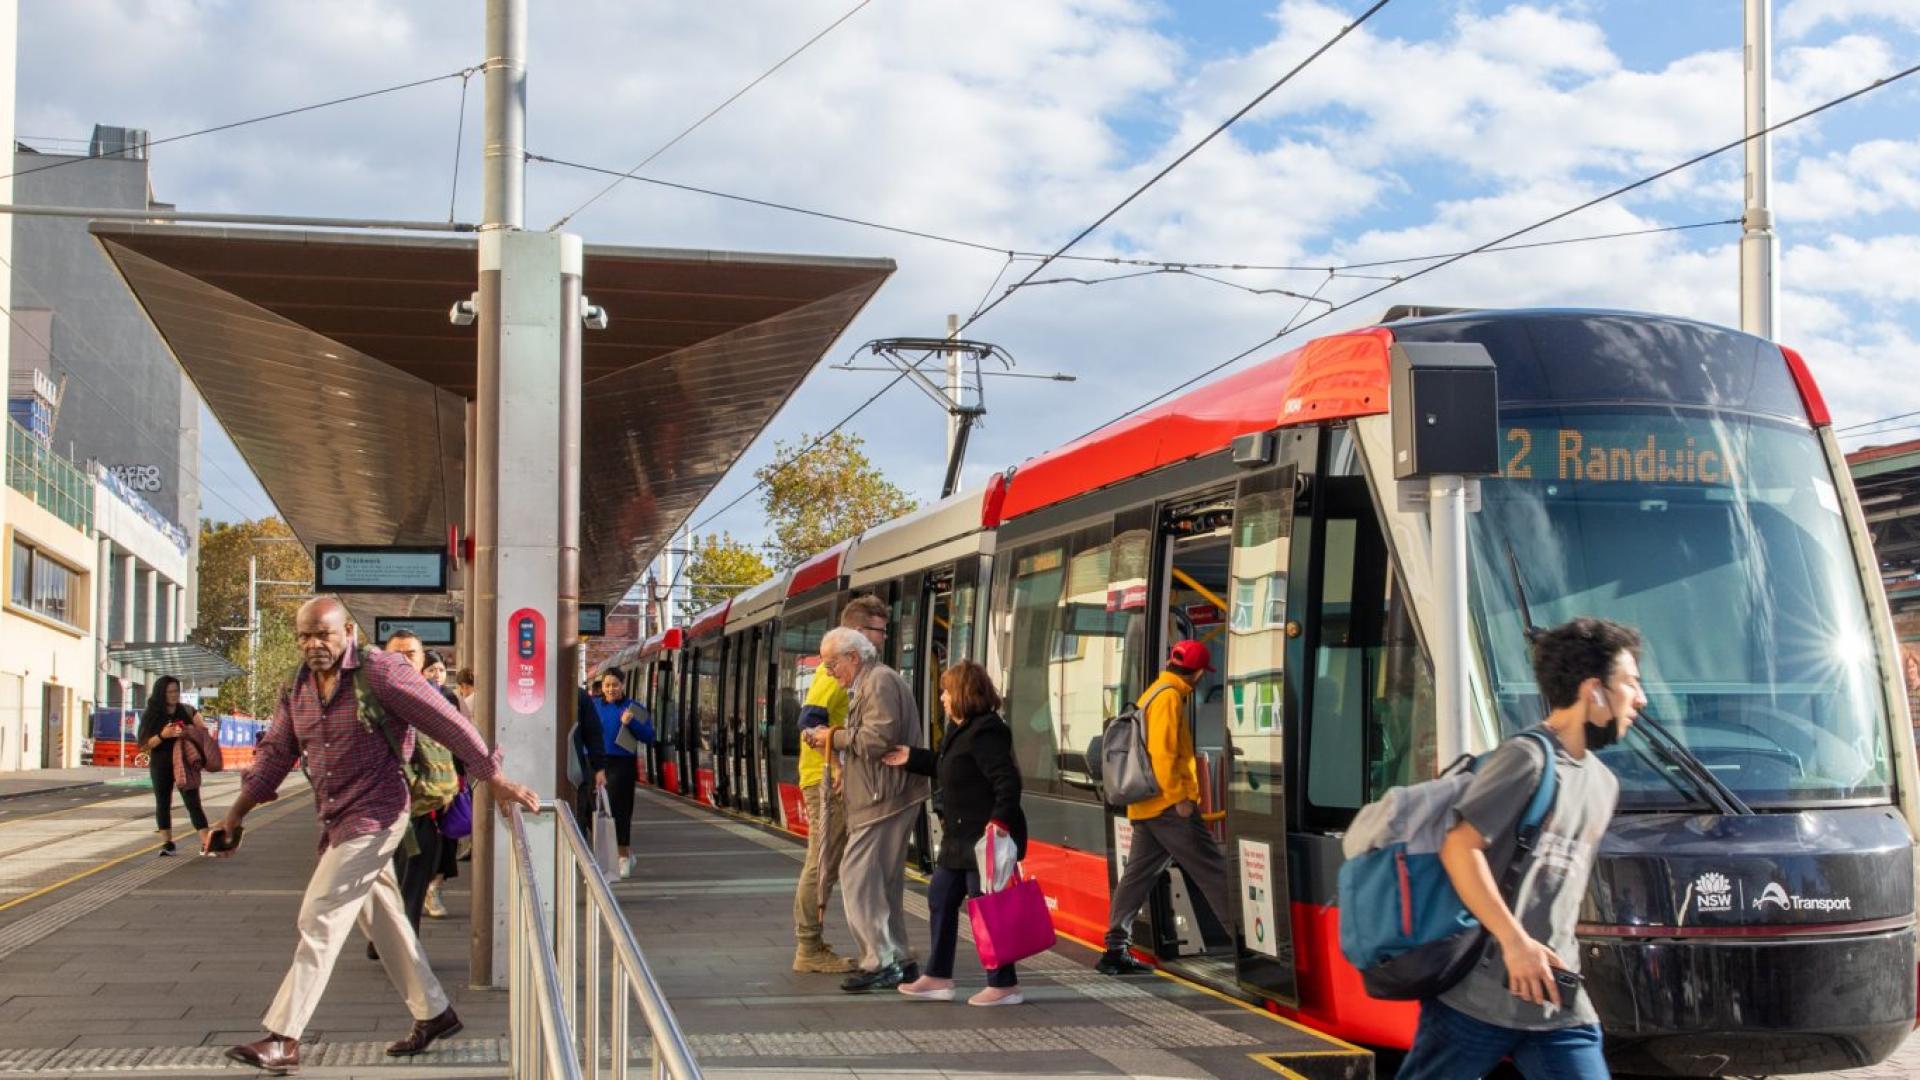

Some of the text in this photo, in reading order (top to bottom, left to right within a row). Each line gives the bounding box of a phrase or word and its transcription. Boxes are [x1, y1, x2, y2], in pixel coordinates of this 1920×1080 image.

[1489, 429, 1533, 479] 2
[1697, 894, 1731, 907] NSW
[1790, 896, 1852, 912] Transport
